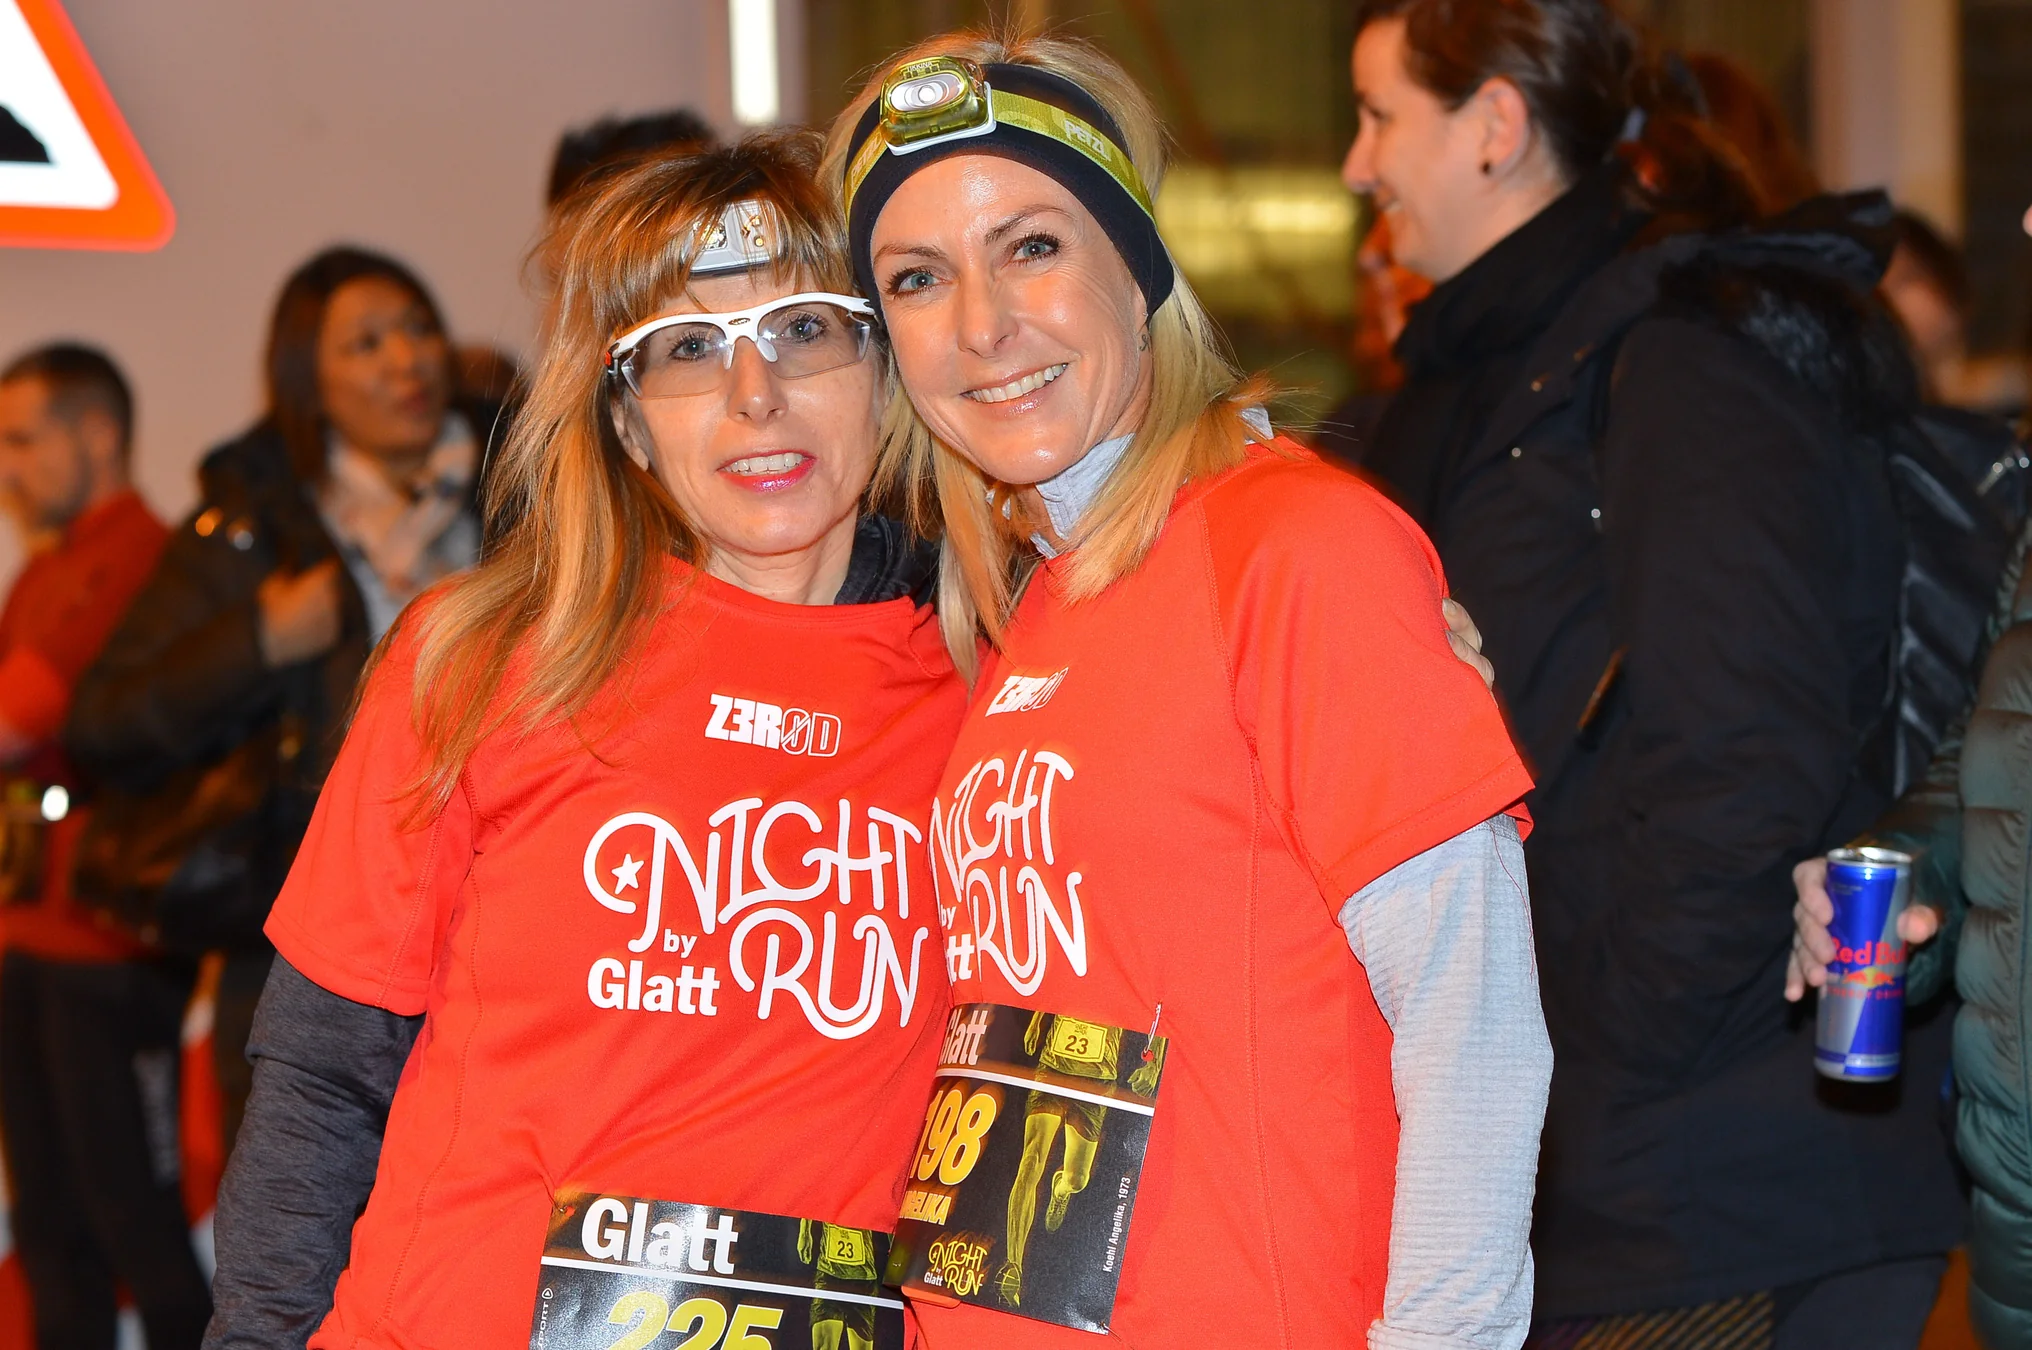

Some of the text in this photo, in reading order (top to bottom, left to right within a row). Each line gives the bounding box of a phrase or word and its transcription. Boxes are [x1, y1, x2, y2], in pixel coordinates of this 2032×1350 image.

[1064, 119, 1111, 161] PETZL
[928, 748, 1075, 912] NIGHT
[583, 797, 922, 953] NIGHT
[664, 928, 697, 960] by
[966, 866, 1088, 996] RUN
[587, 957, 720, 1016] Glatt
[729, 907, 928, 1040] RUN
[938, 1008, 988, 1066] Glatt
[1065, 1035, 1088, 1054] 23
[581, 1199, 738, 1275] Glatt
[837, 1240, 854, 1259] 23
[1103, 1177, 1131, 1272] Koehl Angelika, 1973
[924, 1271, 943, 1287] Glatt
[929, 1241, 988, 1272] NIGHT
[944, 1265, 984, 1296] RUN
[606, 1290, 784, 1350] 225
